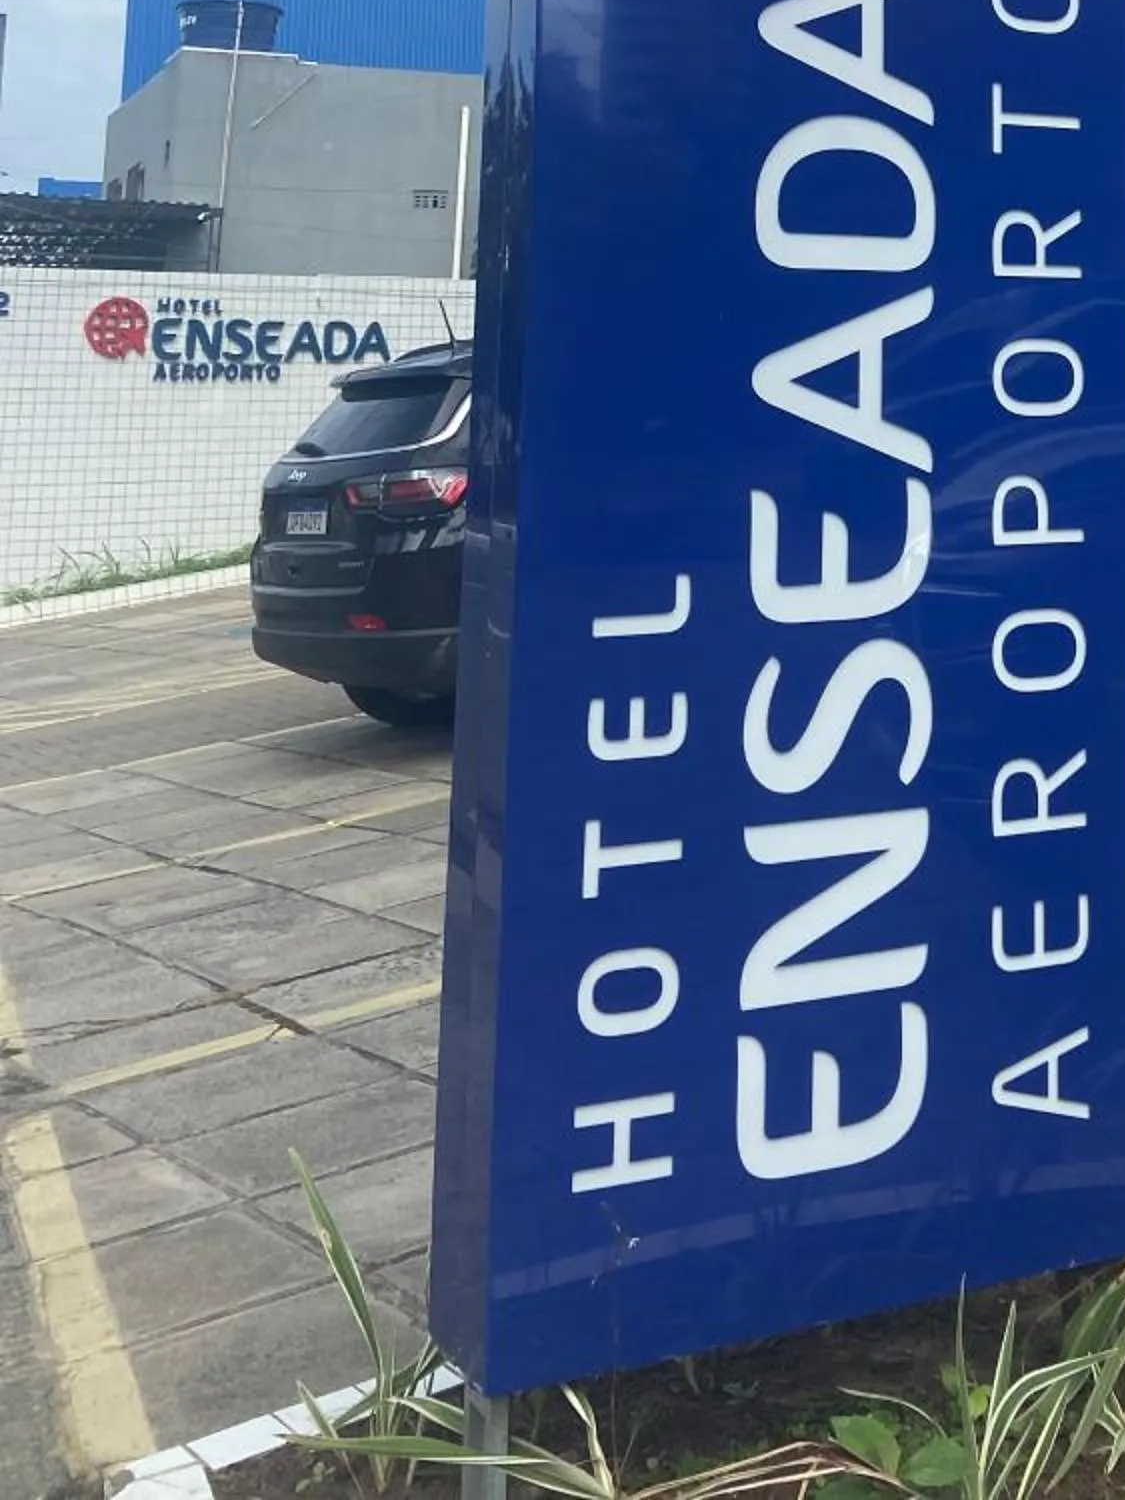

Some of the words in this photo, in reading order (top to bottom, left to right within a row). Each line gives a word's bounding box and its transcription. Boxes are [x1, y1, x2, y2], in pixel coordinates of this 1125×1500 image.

[155, 297, 222, 316] HOTEL
[151, 317, 391, 365] ENSEADA
[152, 363, 282, 382] AEROPORTO
[570, 572, 693, 1195] HOTEL
